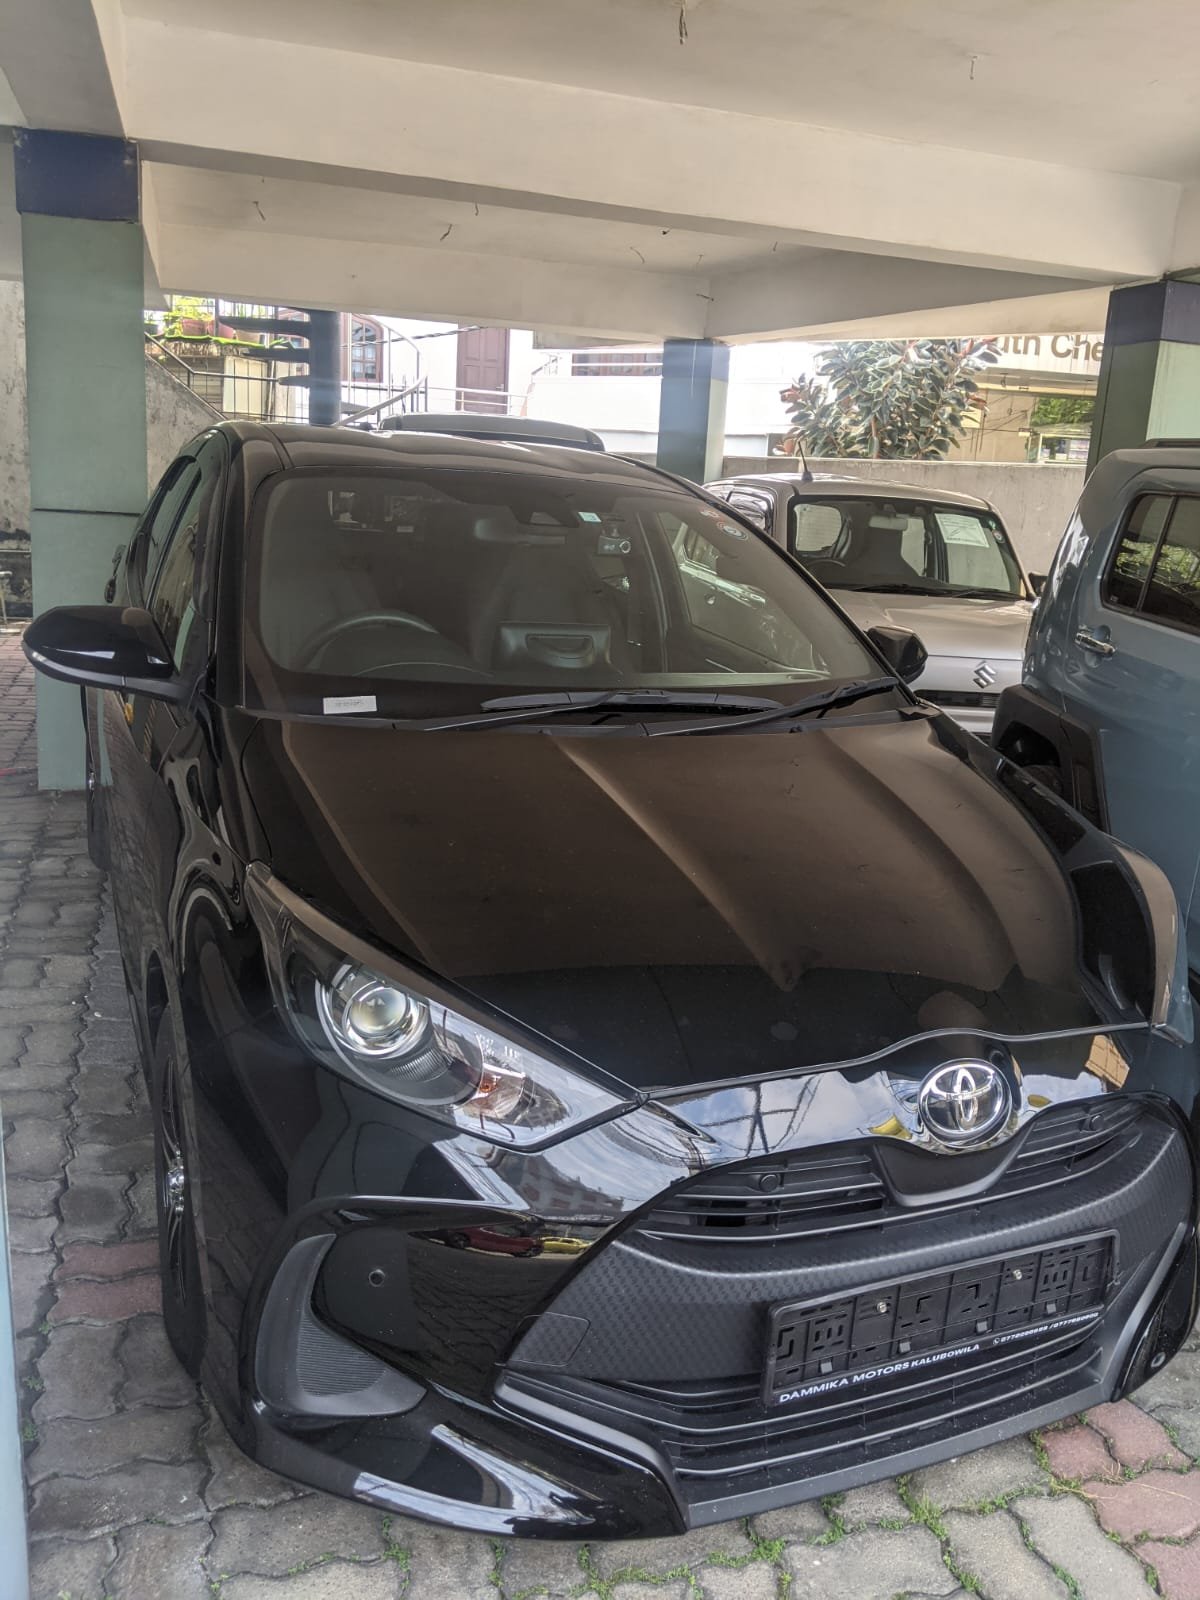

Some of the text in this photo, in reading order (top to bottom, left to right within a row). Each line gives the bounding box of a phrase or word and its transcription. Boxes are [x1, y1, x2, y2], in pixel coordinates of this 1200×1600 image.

[779, 1377, 849, 1403] DAMMIKA
[852, 1361, 910, 1383] MOTORS
[911, 1343, 980, 1368] KALUBOWILA
